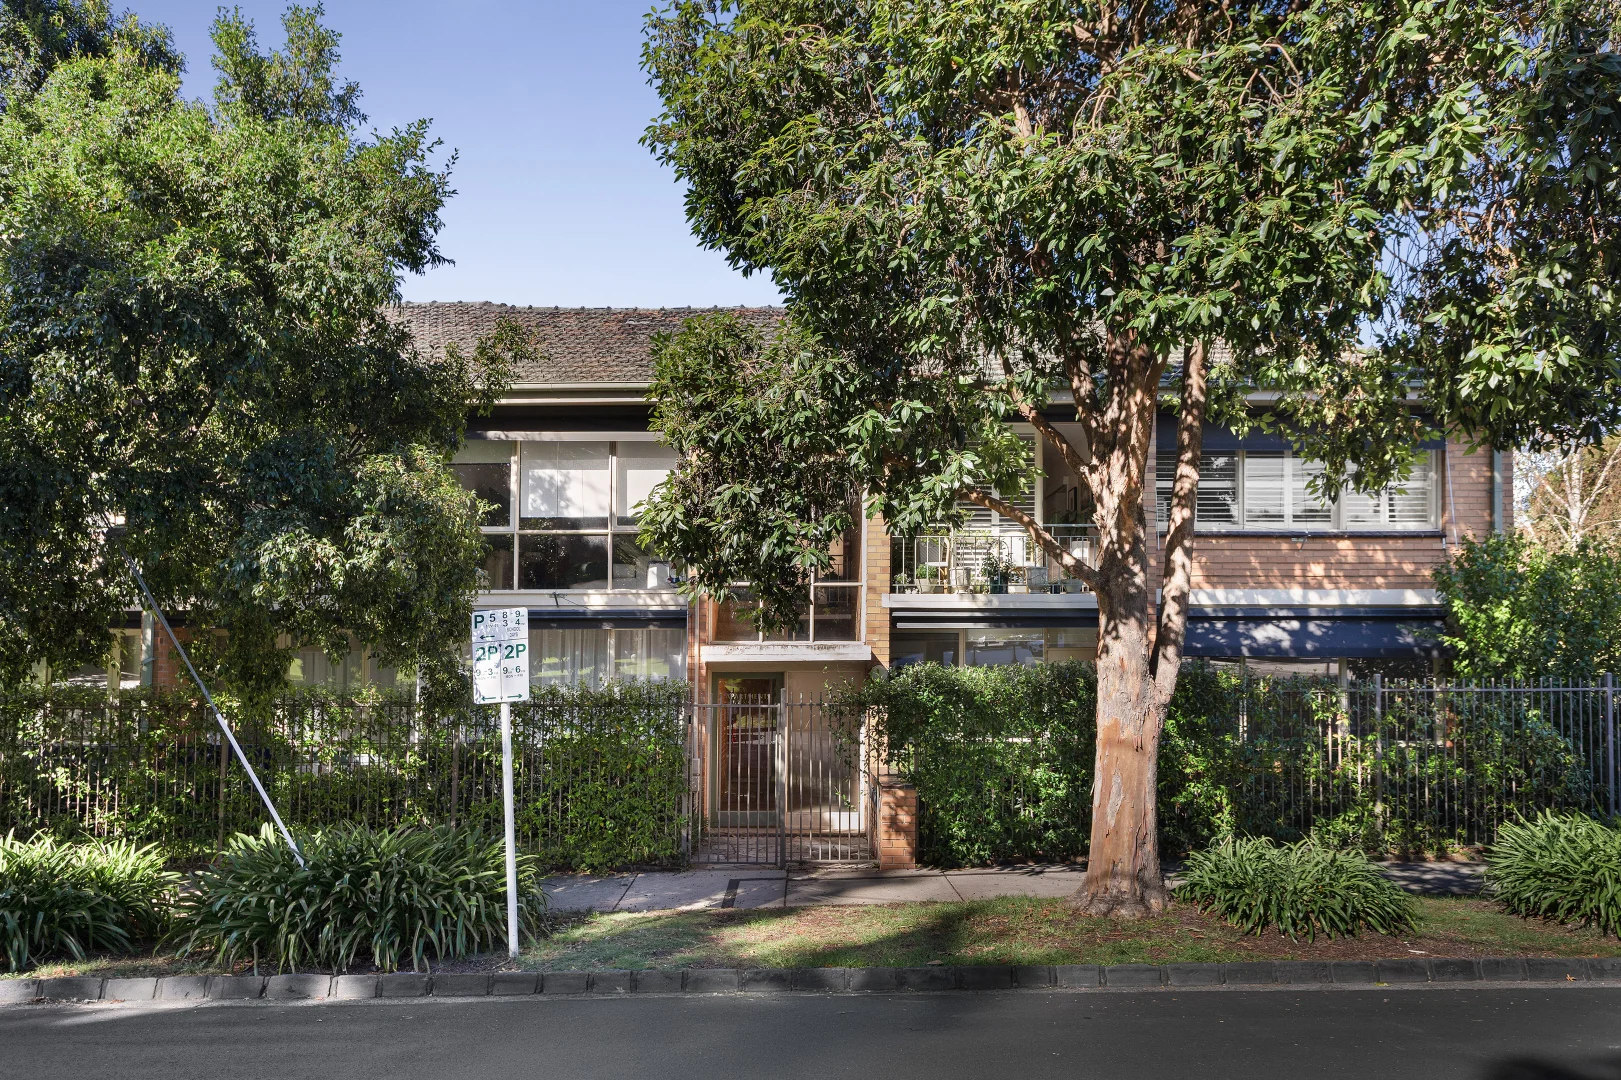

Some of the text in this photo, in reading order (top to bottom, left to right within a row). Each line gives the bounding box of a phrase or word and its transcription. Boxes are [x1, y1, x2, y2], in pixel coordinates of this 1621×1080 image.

[474, 614, 484, 629] P
[489, 614, 496, 622] 5
[476, 646, 498, 661] 2P
[505, 644, 526, 659] 2P
